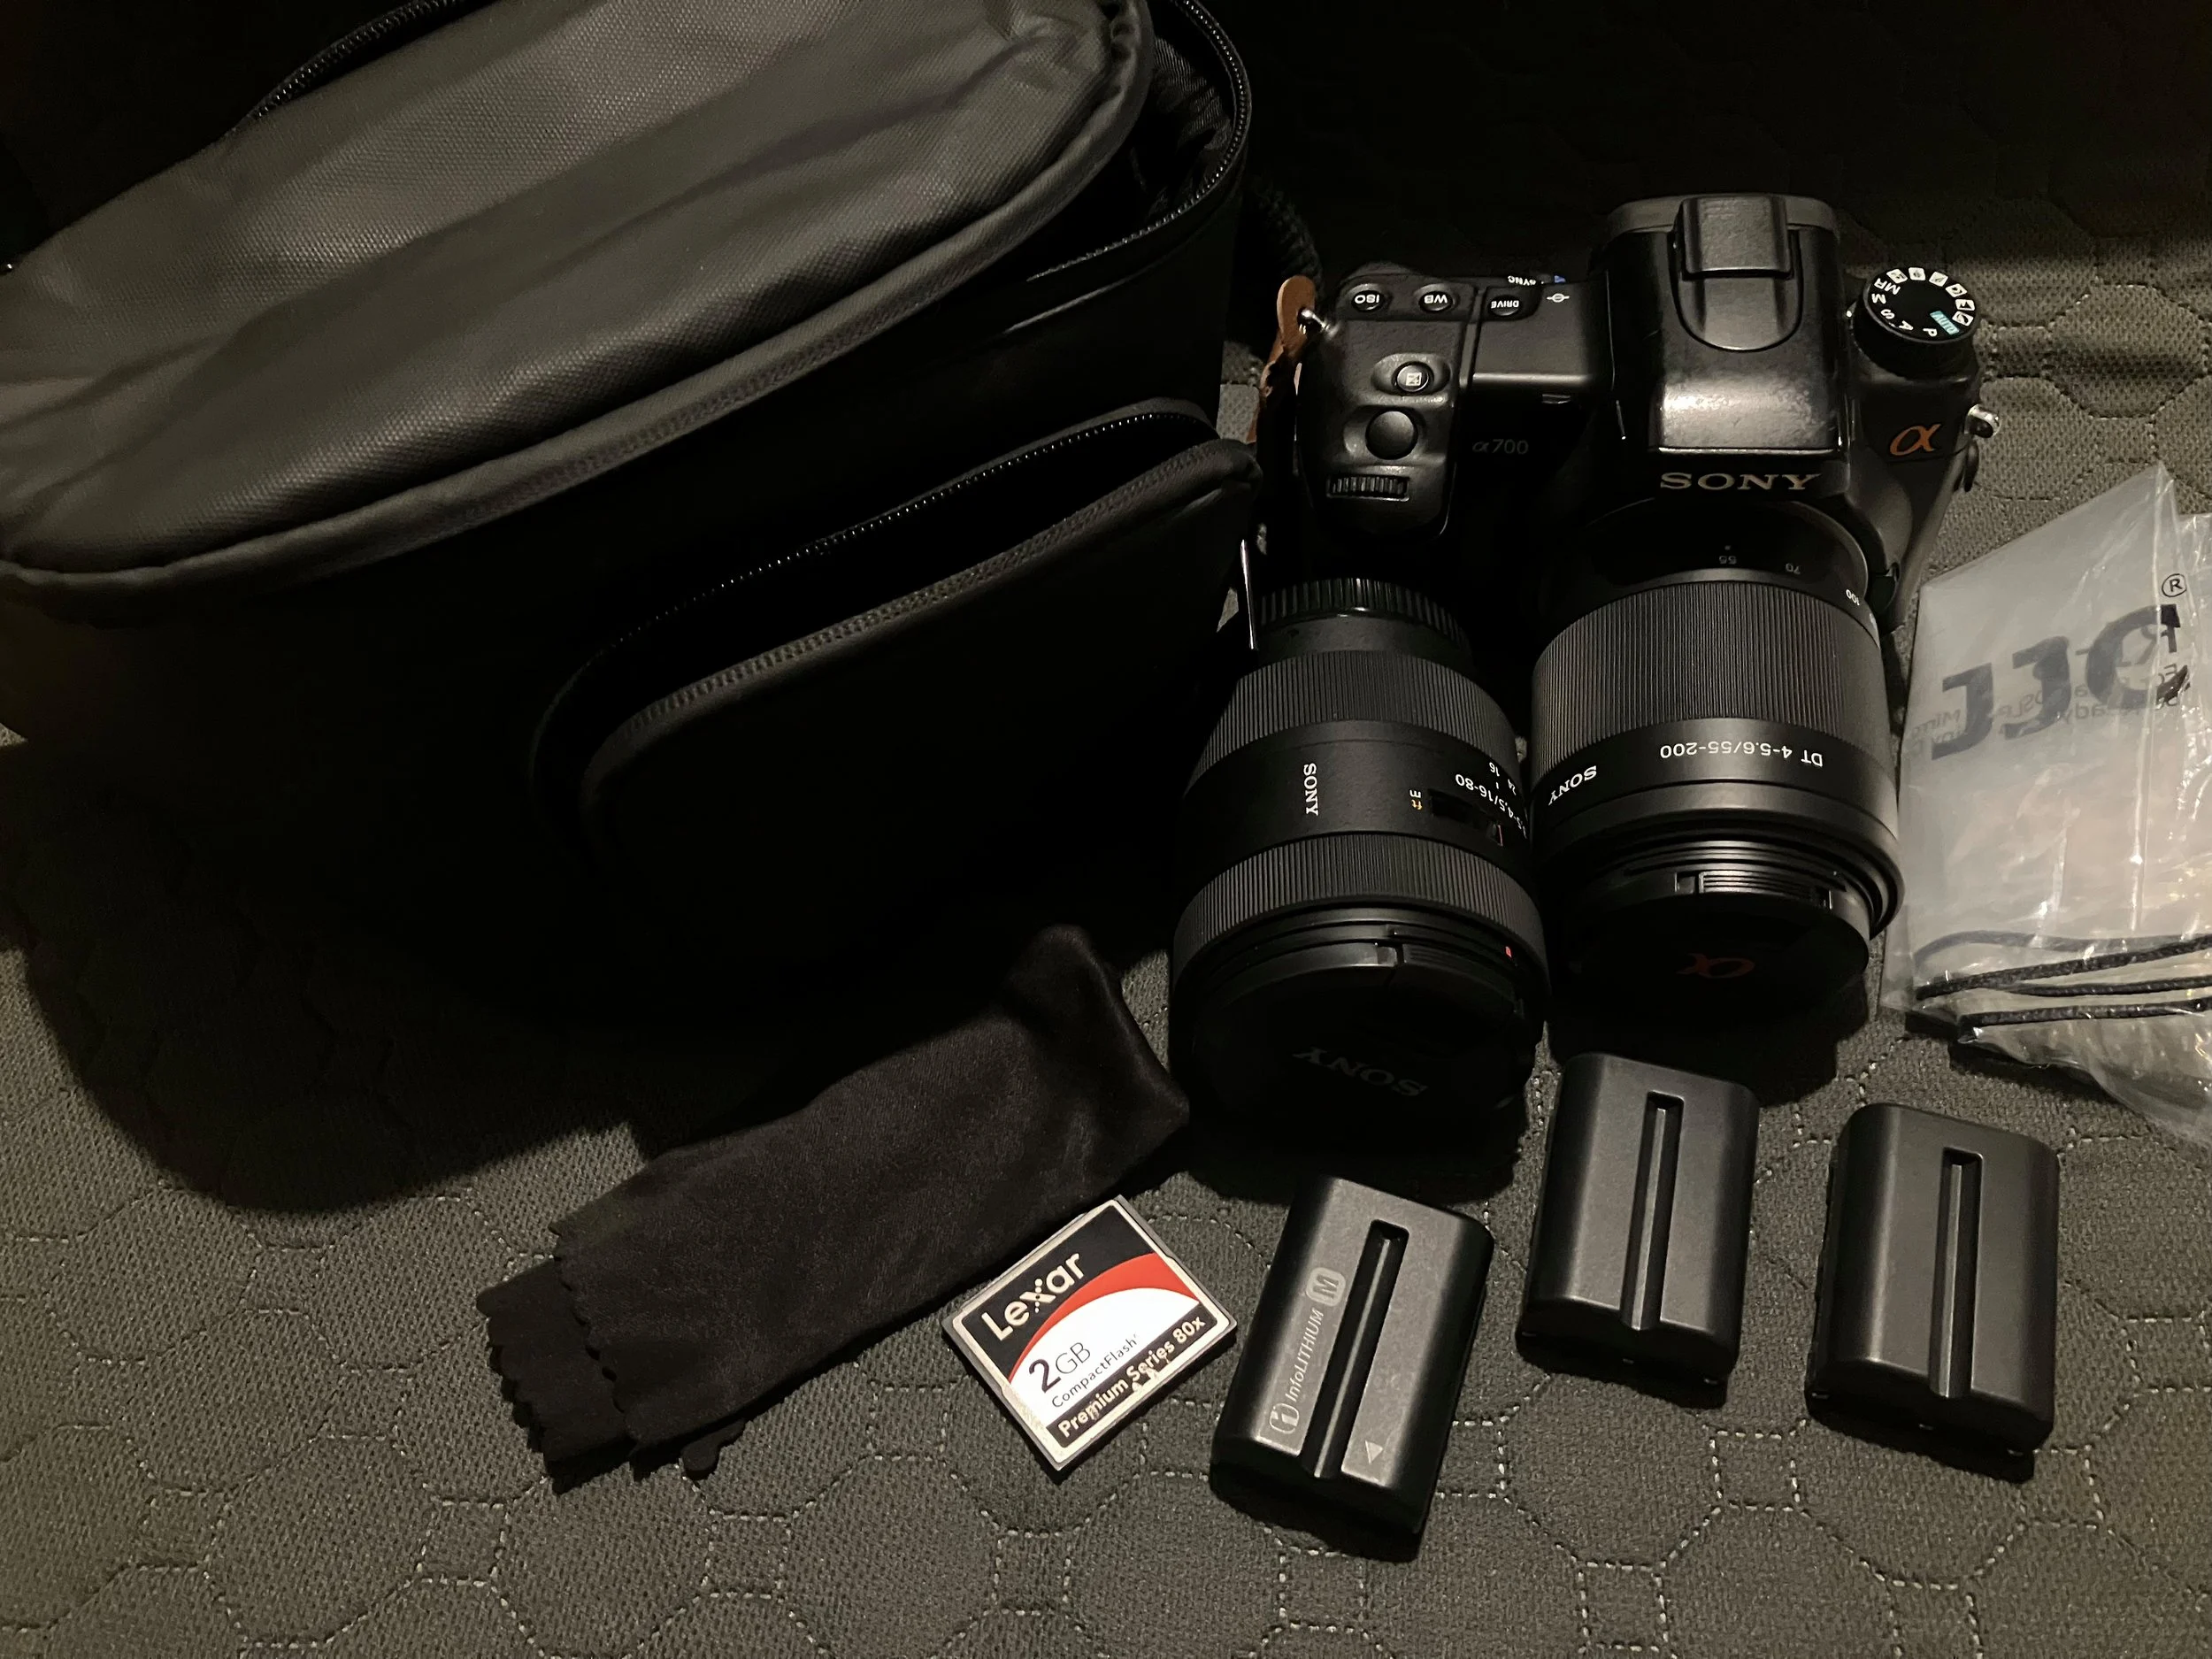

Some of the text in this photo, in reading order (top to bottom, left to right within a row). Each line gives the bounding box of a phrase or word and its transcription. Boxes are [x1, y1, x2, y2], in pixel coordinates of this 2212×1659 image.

[1354, 294, 1380, 304] ISO
[1423, 294, 1448, 304] WB
[1490, 299, 1520, 310] DRIVE
[1870, 293, 1887, 304] M
[1880, 308, 1896, 319] S
[1898, 319, 1915, 331] A
[1923, 327, 1938, 337] P
[1659, 472, 1823, 491] SONY
[1718, 555, 1738, 565] 55
[1785, 562, 1801, 576] 70
[1659, 741, 1824, 768] DT 4-5.6/55-200
[1302, 762, 1319, 817] SONY
[1548, 765, 1598, 806] SONY
[1292, 1045, 1429, 1096] SONY
[980, 1253, 1085, 1341] Lexar
[1284, 1307, 1324, 1403] InfoLITHIUM
[1029, 1341, 1091, 1393] 2GB
[1057, 1316, 1207, 1439] Premium Series 80x
